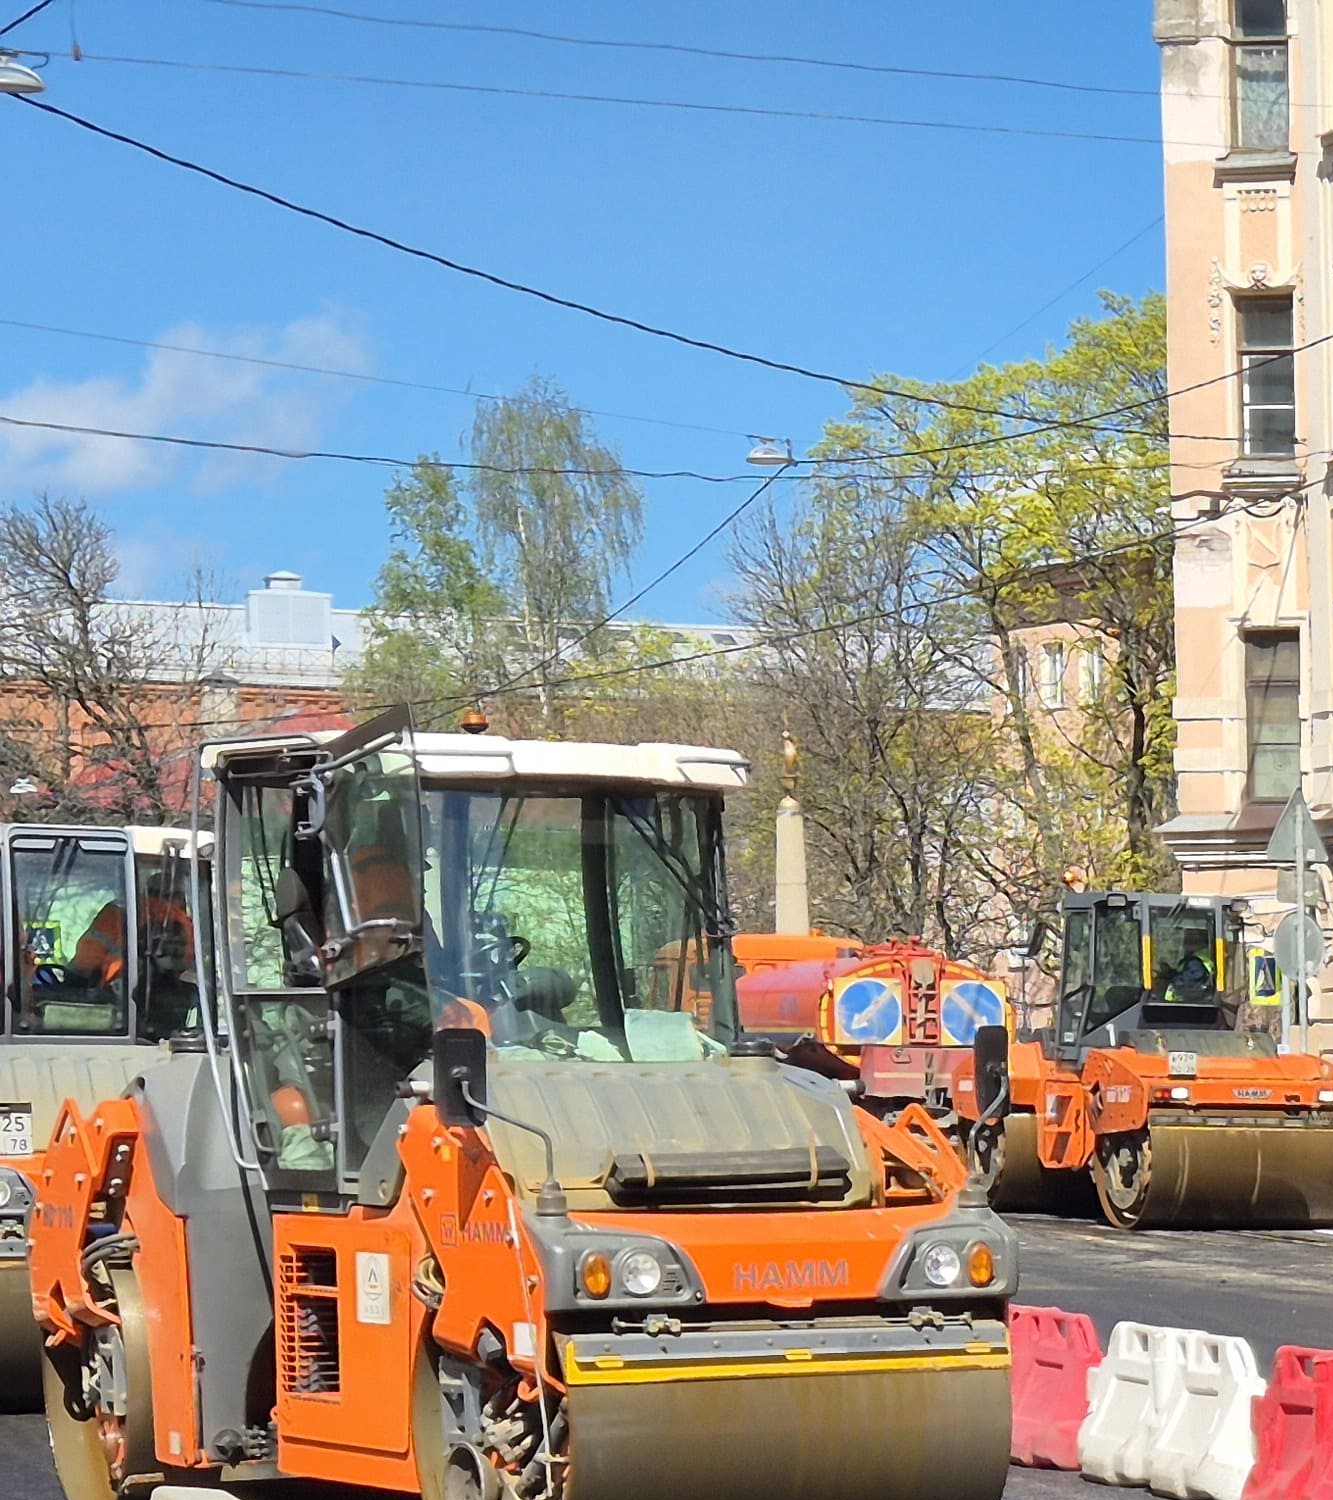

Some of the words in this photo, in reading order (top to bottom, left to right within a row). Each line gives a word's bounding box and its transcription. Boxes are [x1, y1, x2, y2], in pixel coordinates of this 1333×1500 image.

[2, 1116, 24, 1132] 25
[10, 1138, 28, 1151] 78
[734, 1259, 848, 1291] HAMM
